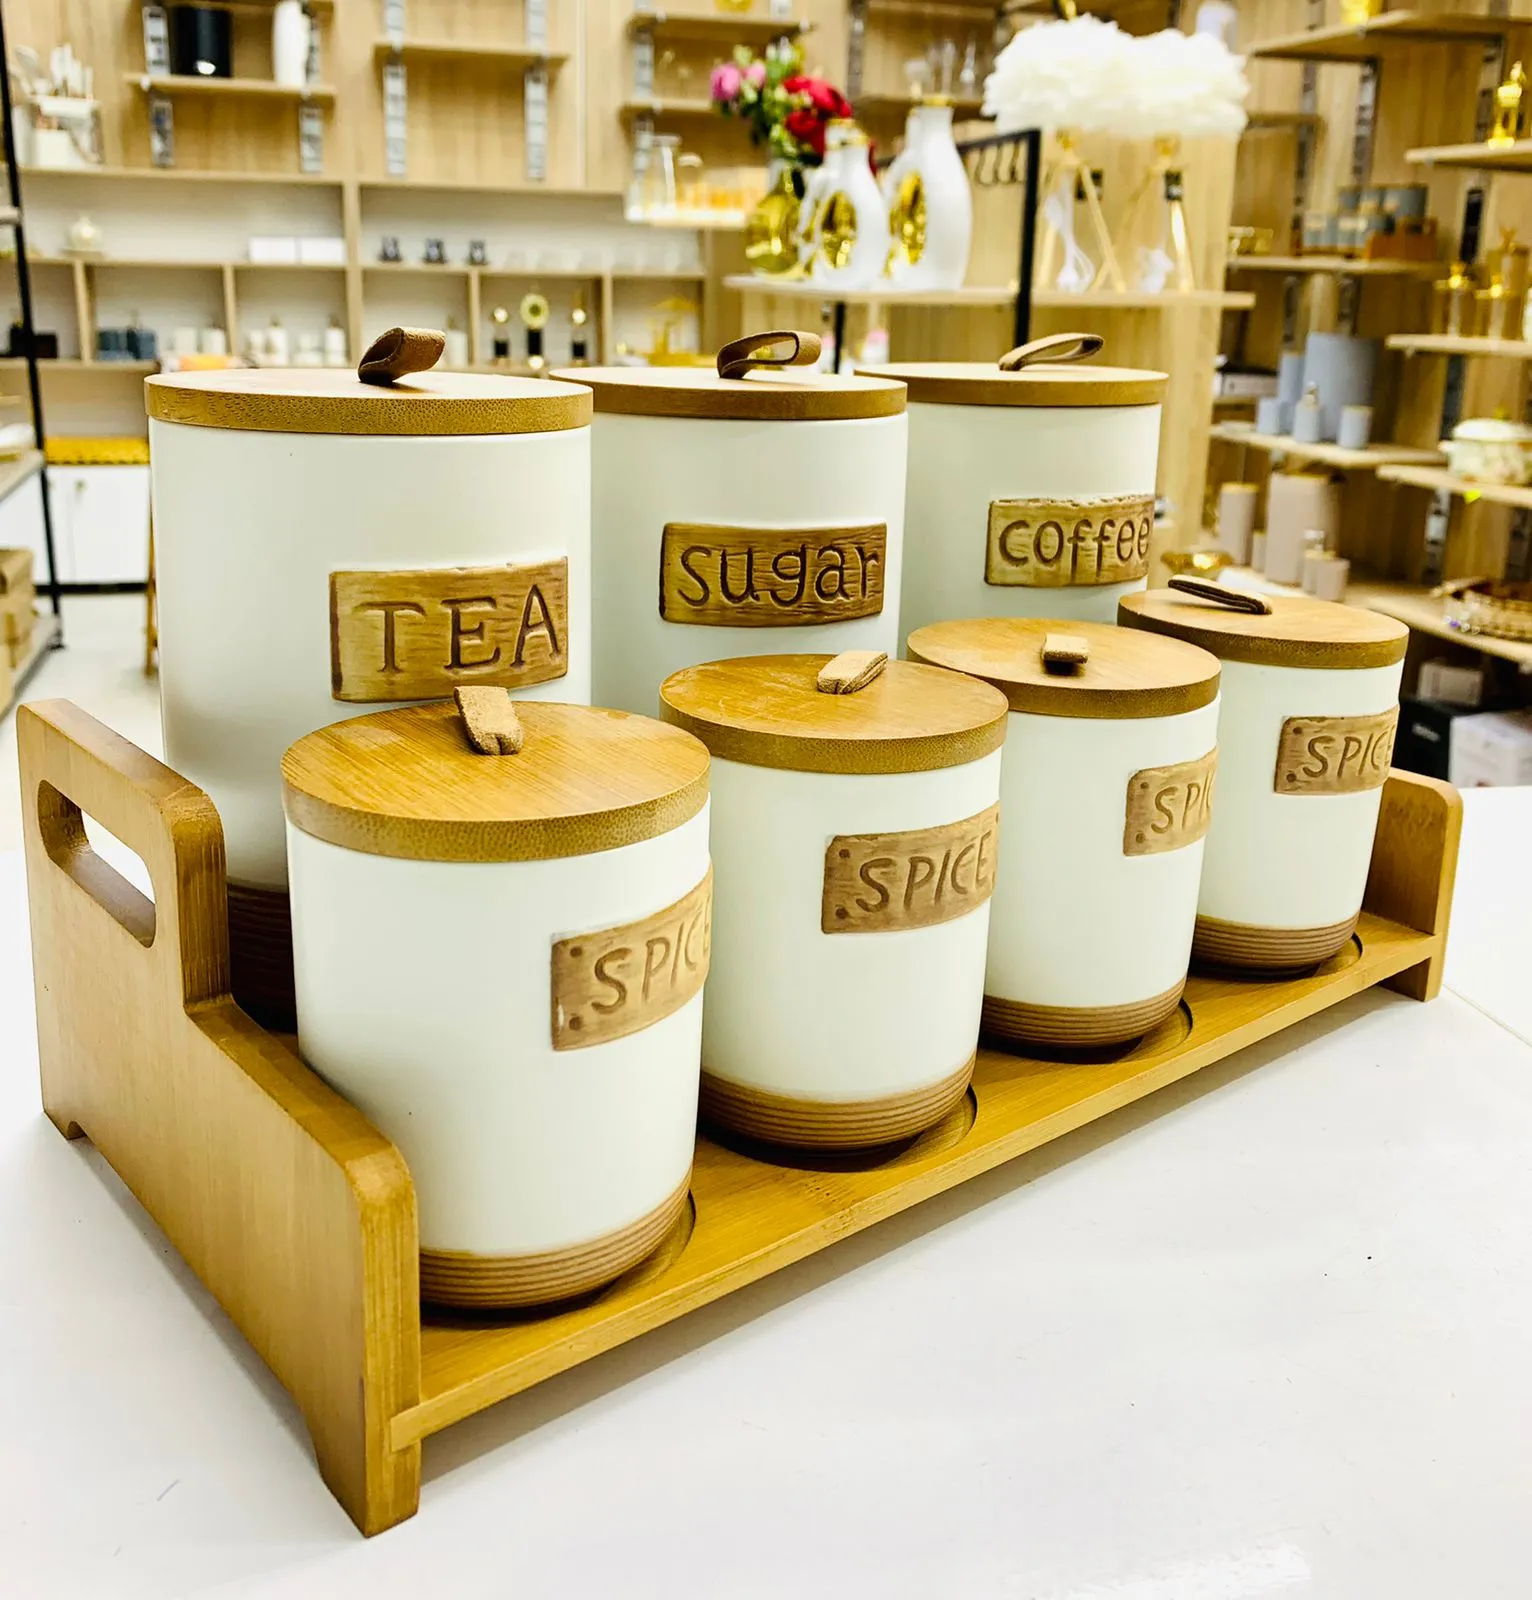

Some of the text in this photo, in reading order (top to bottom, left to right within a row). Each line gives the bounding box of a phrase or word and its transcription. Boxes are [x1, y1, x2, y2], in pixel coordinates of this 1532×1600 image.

[677, 543, 880, 608] sugar
[998, 518, 1150, 582] coffee
[352, 583, 562, 675] TEA
[855, 829, 993, 913] SPICE
